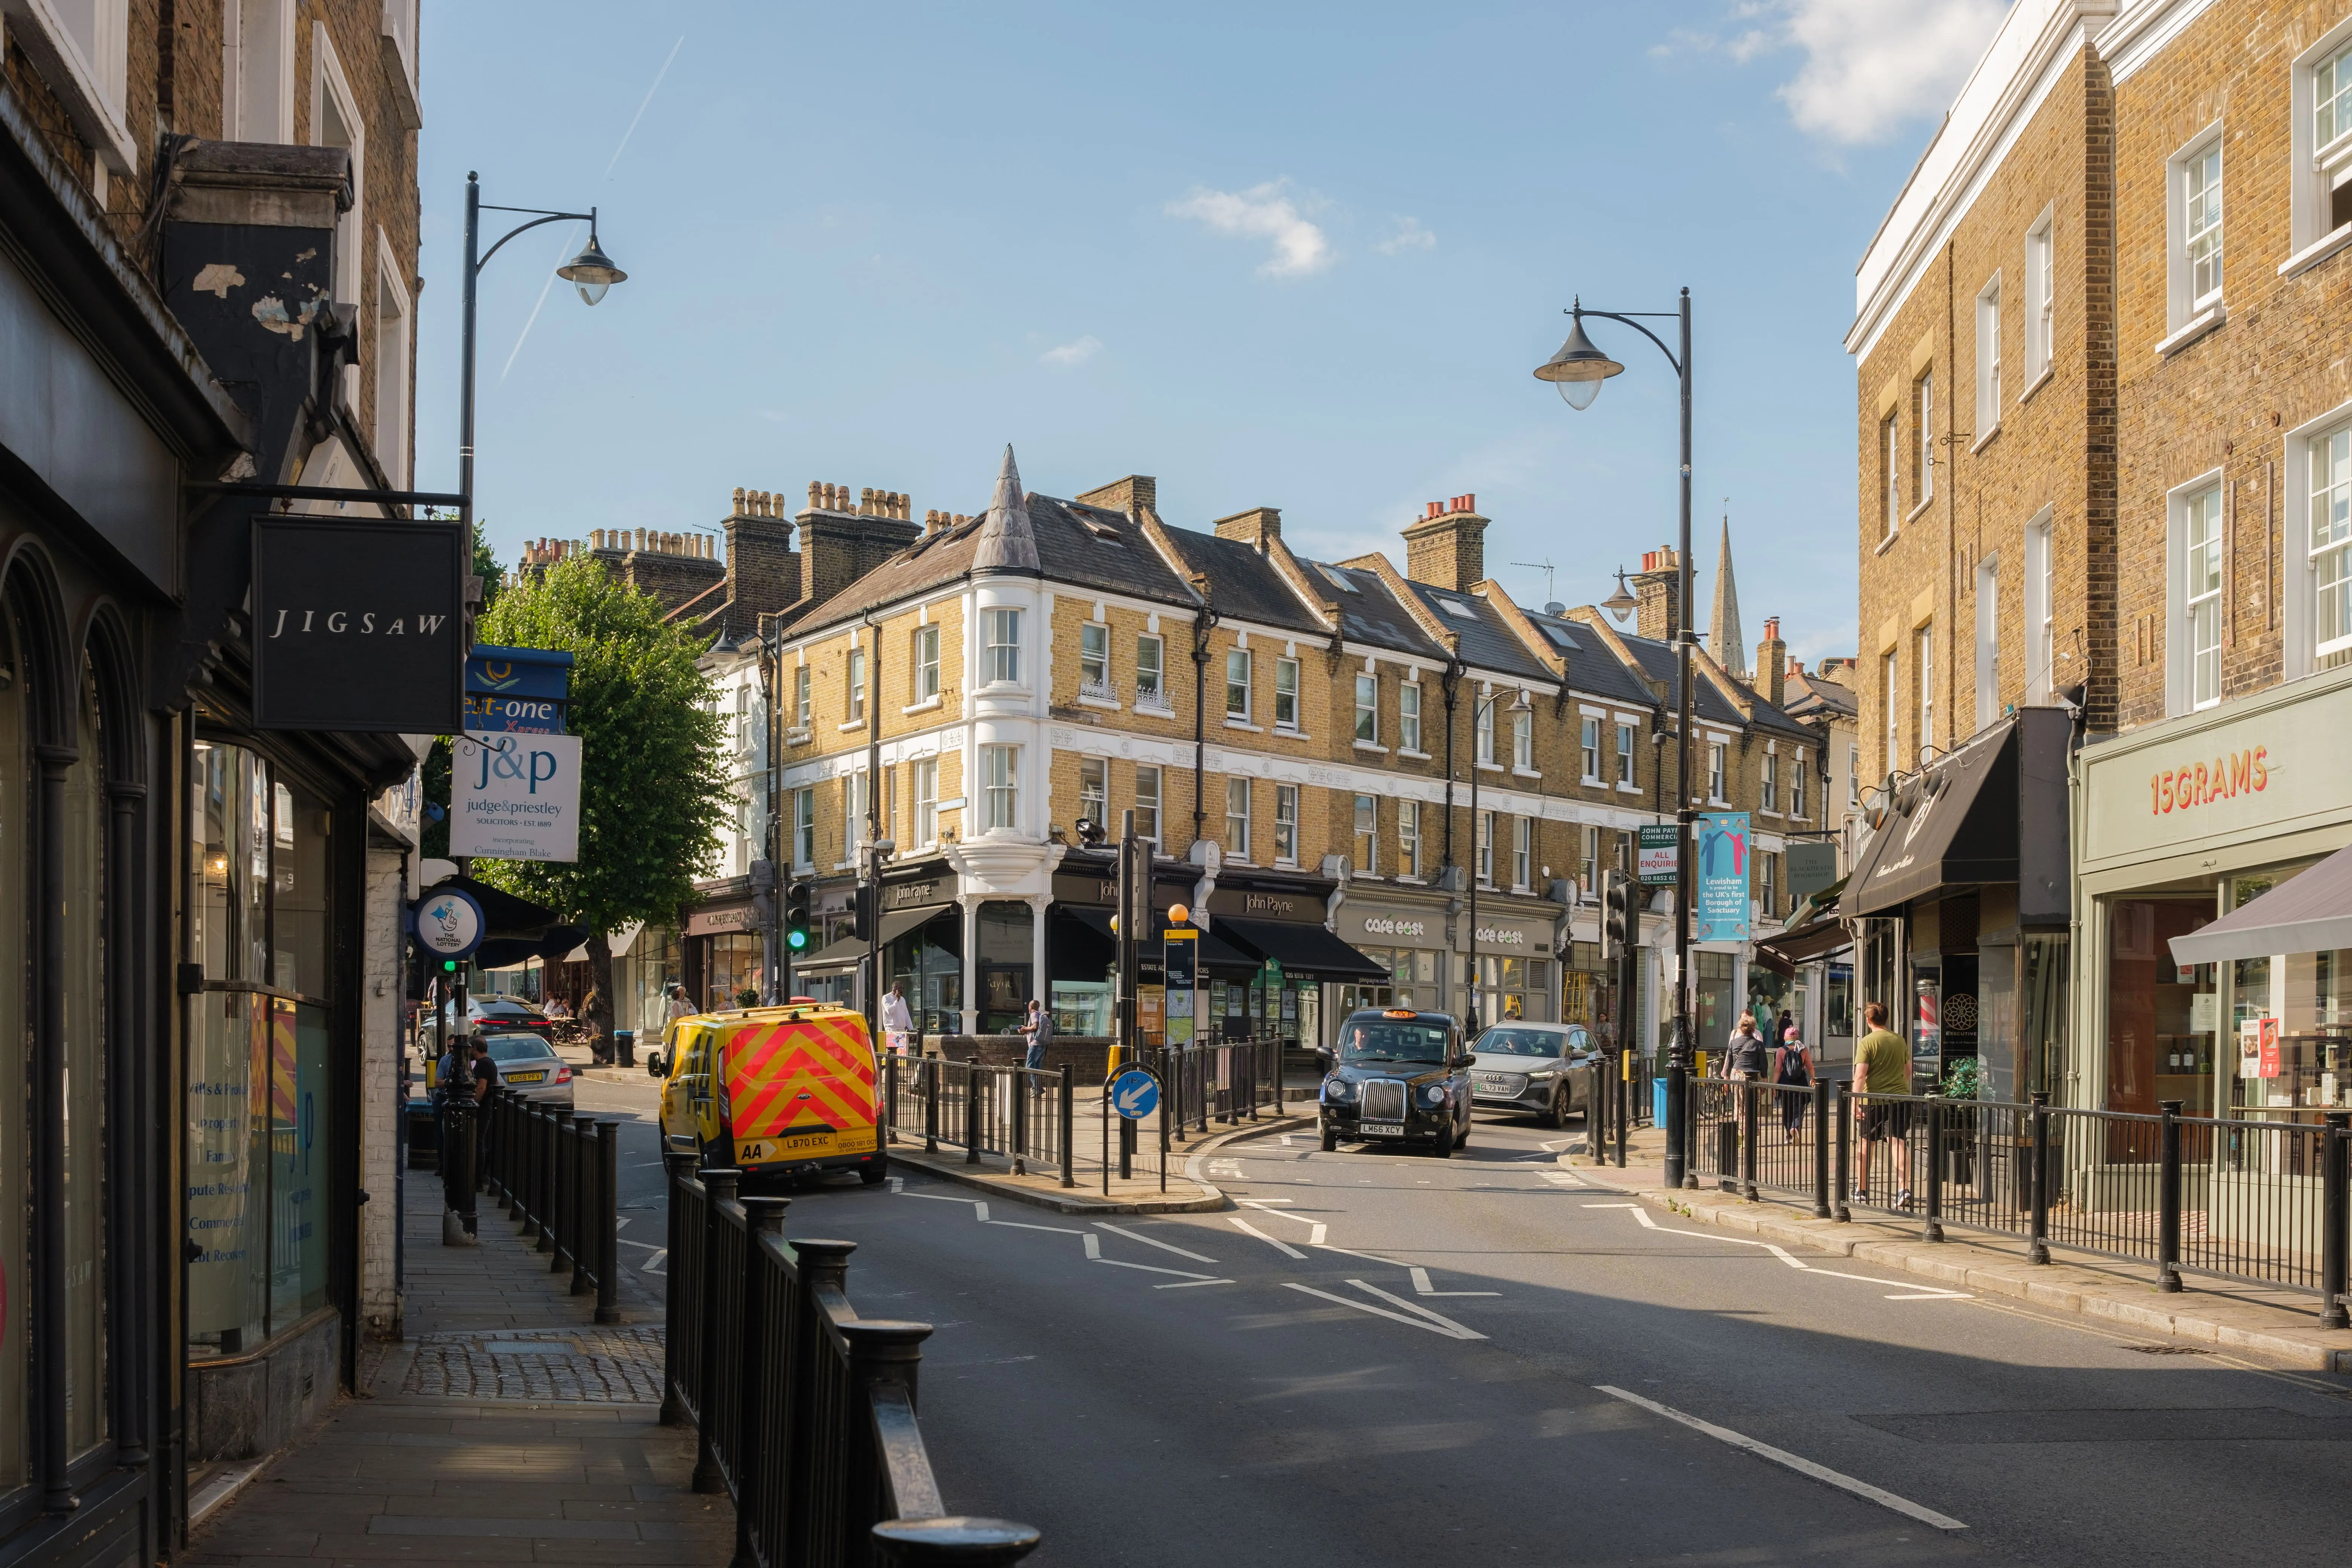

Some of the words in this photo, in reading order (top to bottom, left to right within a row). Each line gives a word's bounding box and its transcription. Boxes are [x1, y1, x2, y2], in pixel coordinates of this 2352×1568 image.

[269, 610, 447, 638] JIGSAW
[464, 697, 552, 720] est-one
[504, 720, 550, 734] Xpress
[473, 736, 557, 794] j&p
[2151, 745, 2267, 815] 15GRAMS
[466, 798, 562, 818] judge&priestley
[493, 836, 534, 845] incorporating
[475, 846, 527, 856] Cunningham
[530, 848, 551, 857] Blake
[1640, 861, 1677, 869] ENQUIRIE
[1246, 894, 1265, 914] John
[1268, 897, 1293, 916] Payne
[1395, 920, 1423, 936] east
[1496, 930, 1523, 944] east
[1358, 976, 1389, 985] johnpayne.com
[787, 1138, 810, 1148] LB70
[812, 1136, 829, 1146] EXC
[741, 1144, 762, 1160] AA
[189, 1184, 214, 1200] pute
[65, 1259, 92, 1289] GSAW
